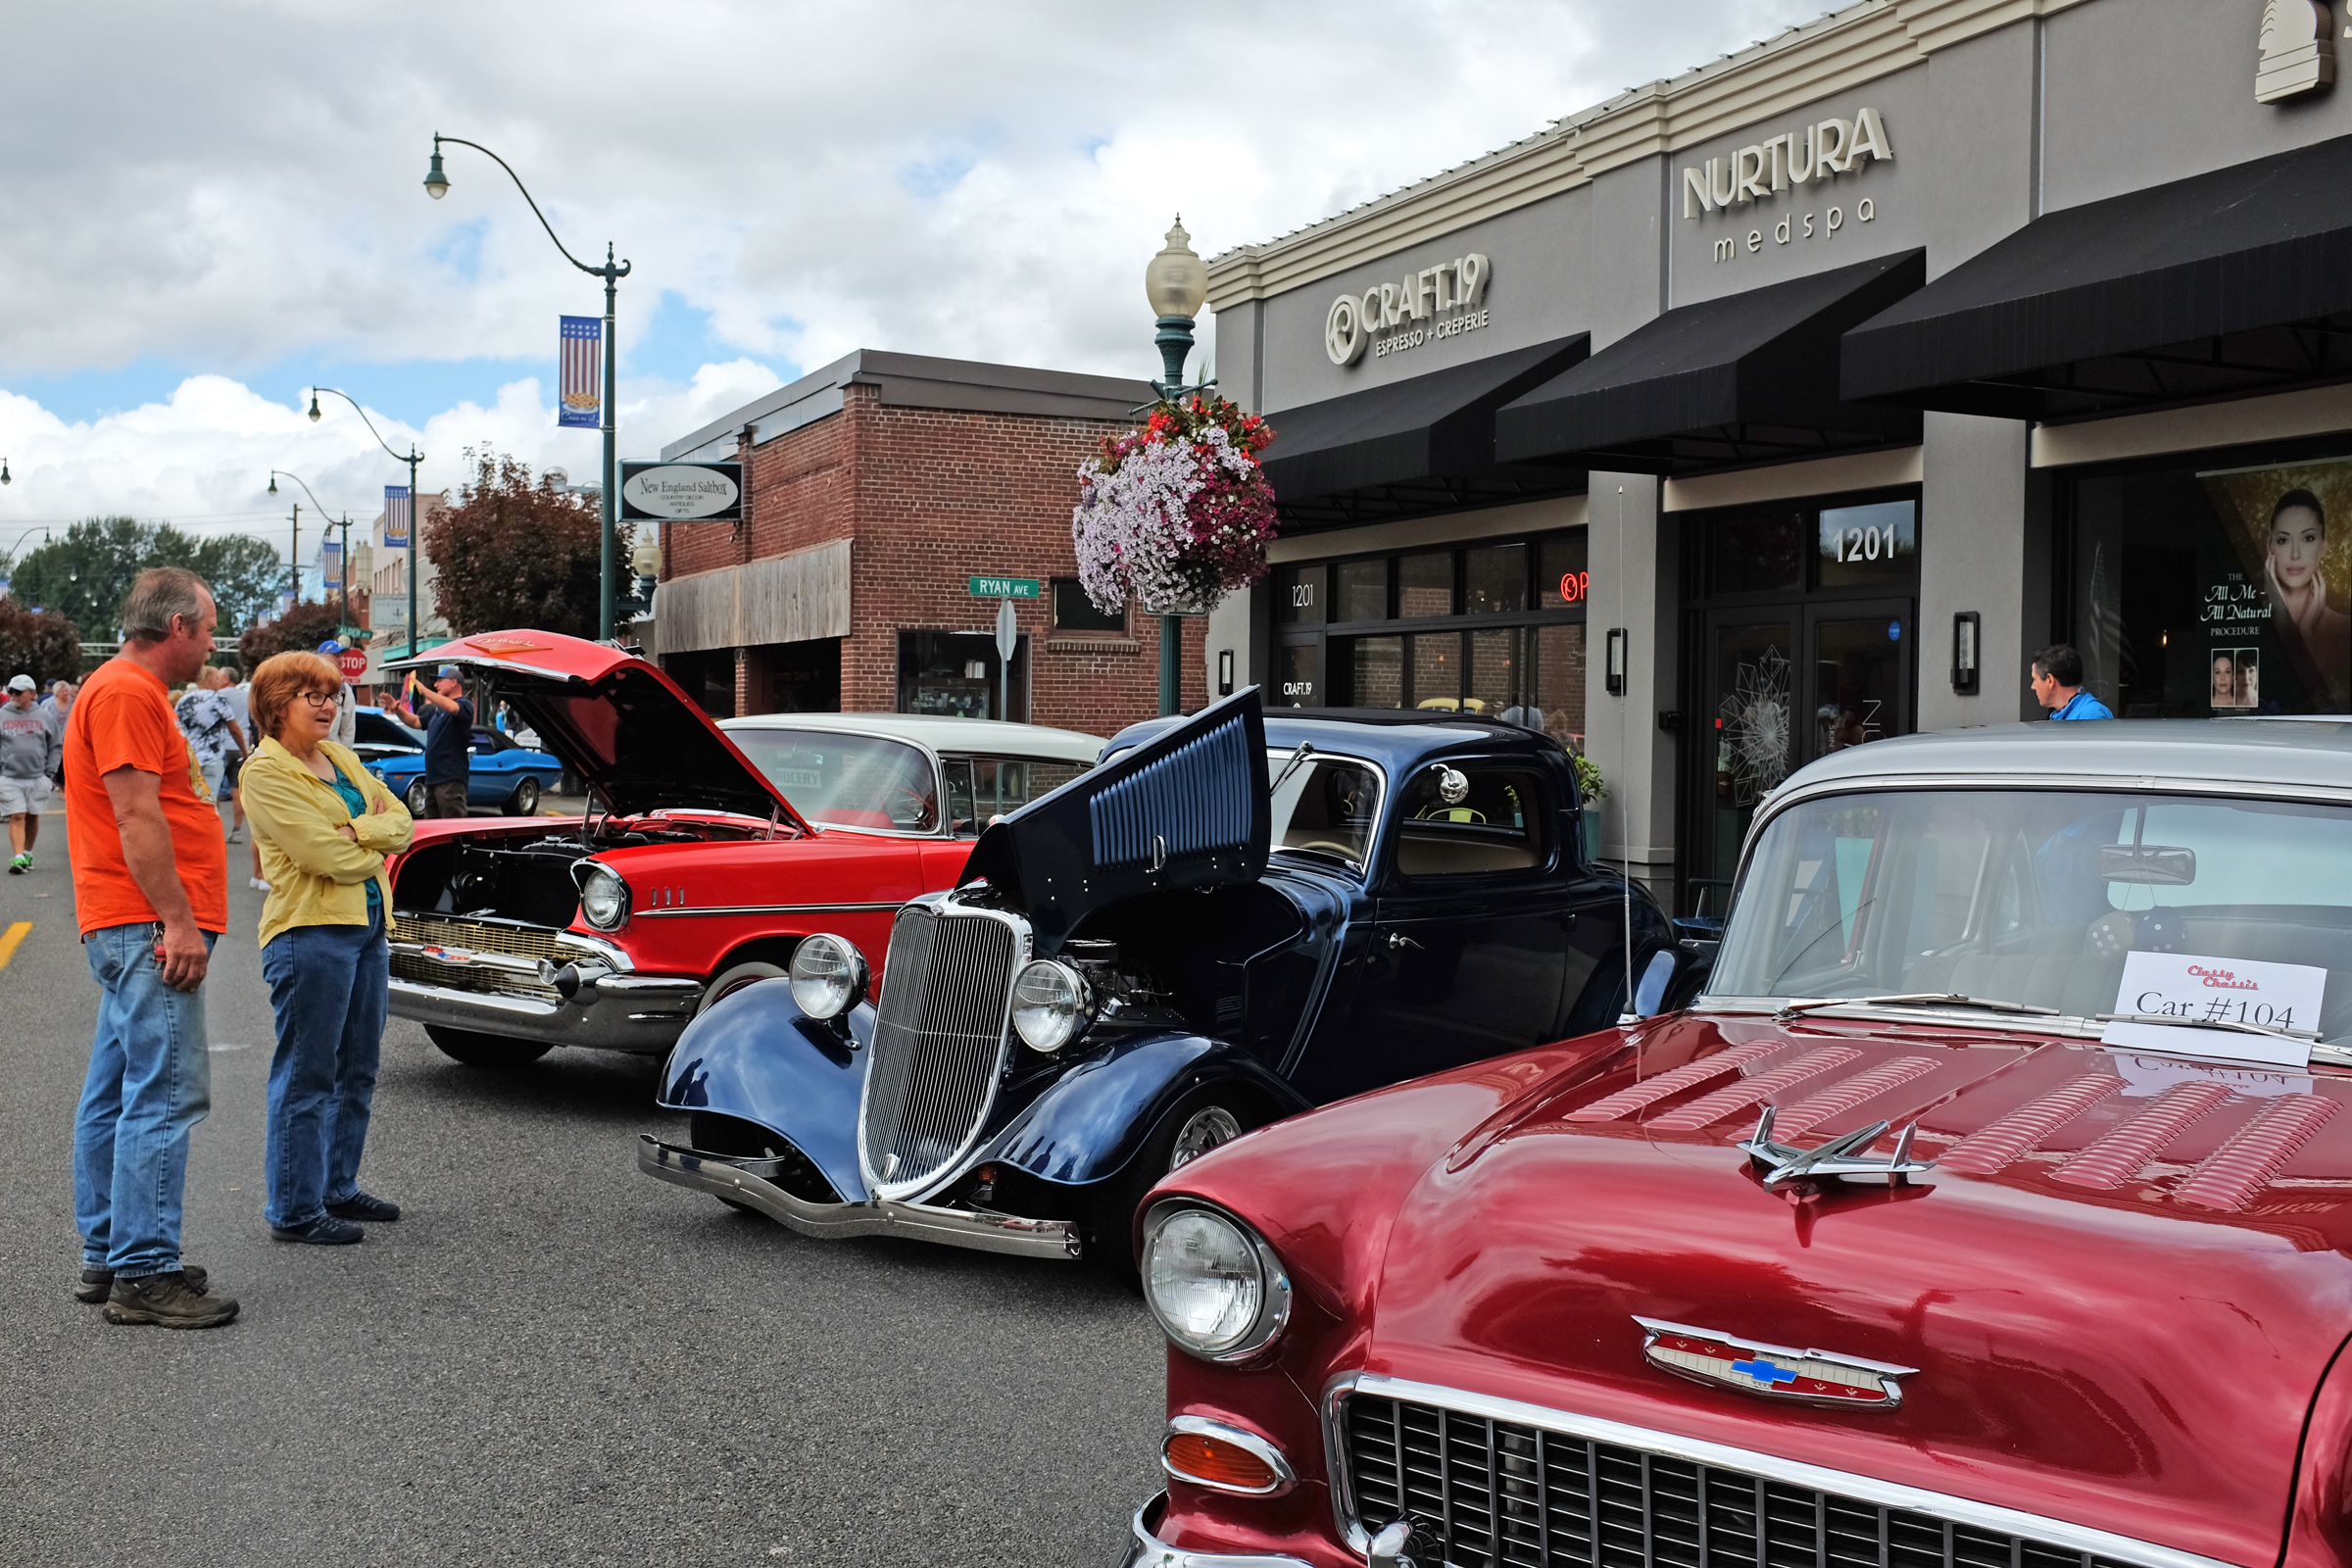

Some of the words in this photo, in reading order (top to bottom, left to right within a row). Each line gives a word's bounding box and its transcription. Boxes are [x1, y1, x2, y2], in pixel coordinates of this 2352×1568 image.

[1684, 107, 1892, 220] NURTURA
[1714, 198, 1876, 263] medspa
[1360, 253, 1489, 333] CRAFT.19
[1376, 328, 1424, 358] ESPRESSO
[1437, 309, 1490, 339] CREPERIE
[640, 476, 659, 495] New
[662, 480, 697, 494] England
[698, 479, 727, 496] Saltbox
[1833, 523, 1895, 564] 1201
[980, 579, 1010, 594] RYAN
[1013, 585, 1029, 595] AVE
[1292, 583, 1314, 608] 1201
[2204, 585, 2230, 603] All
[2230, 584, 2257, 602] Me
[2200, 605, 2225, 622] All
[2226, 603, 2273, 621] Natural
[339, 627, 362, 637] ALDER
[2210, 626, 2261, 637] PROCEDURE
[341, 657, 367, 669] STOP
[1283, 682, 1312, 696] CRAFT.19
[2187, 964, 2235, 982] Classy
[2202, 976, 2260, 991] Chassis
[2135, 991, 2194, 1017] Car
[2205, 997, 2295, 1029] #104
